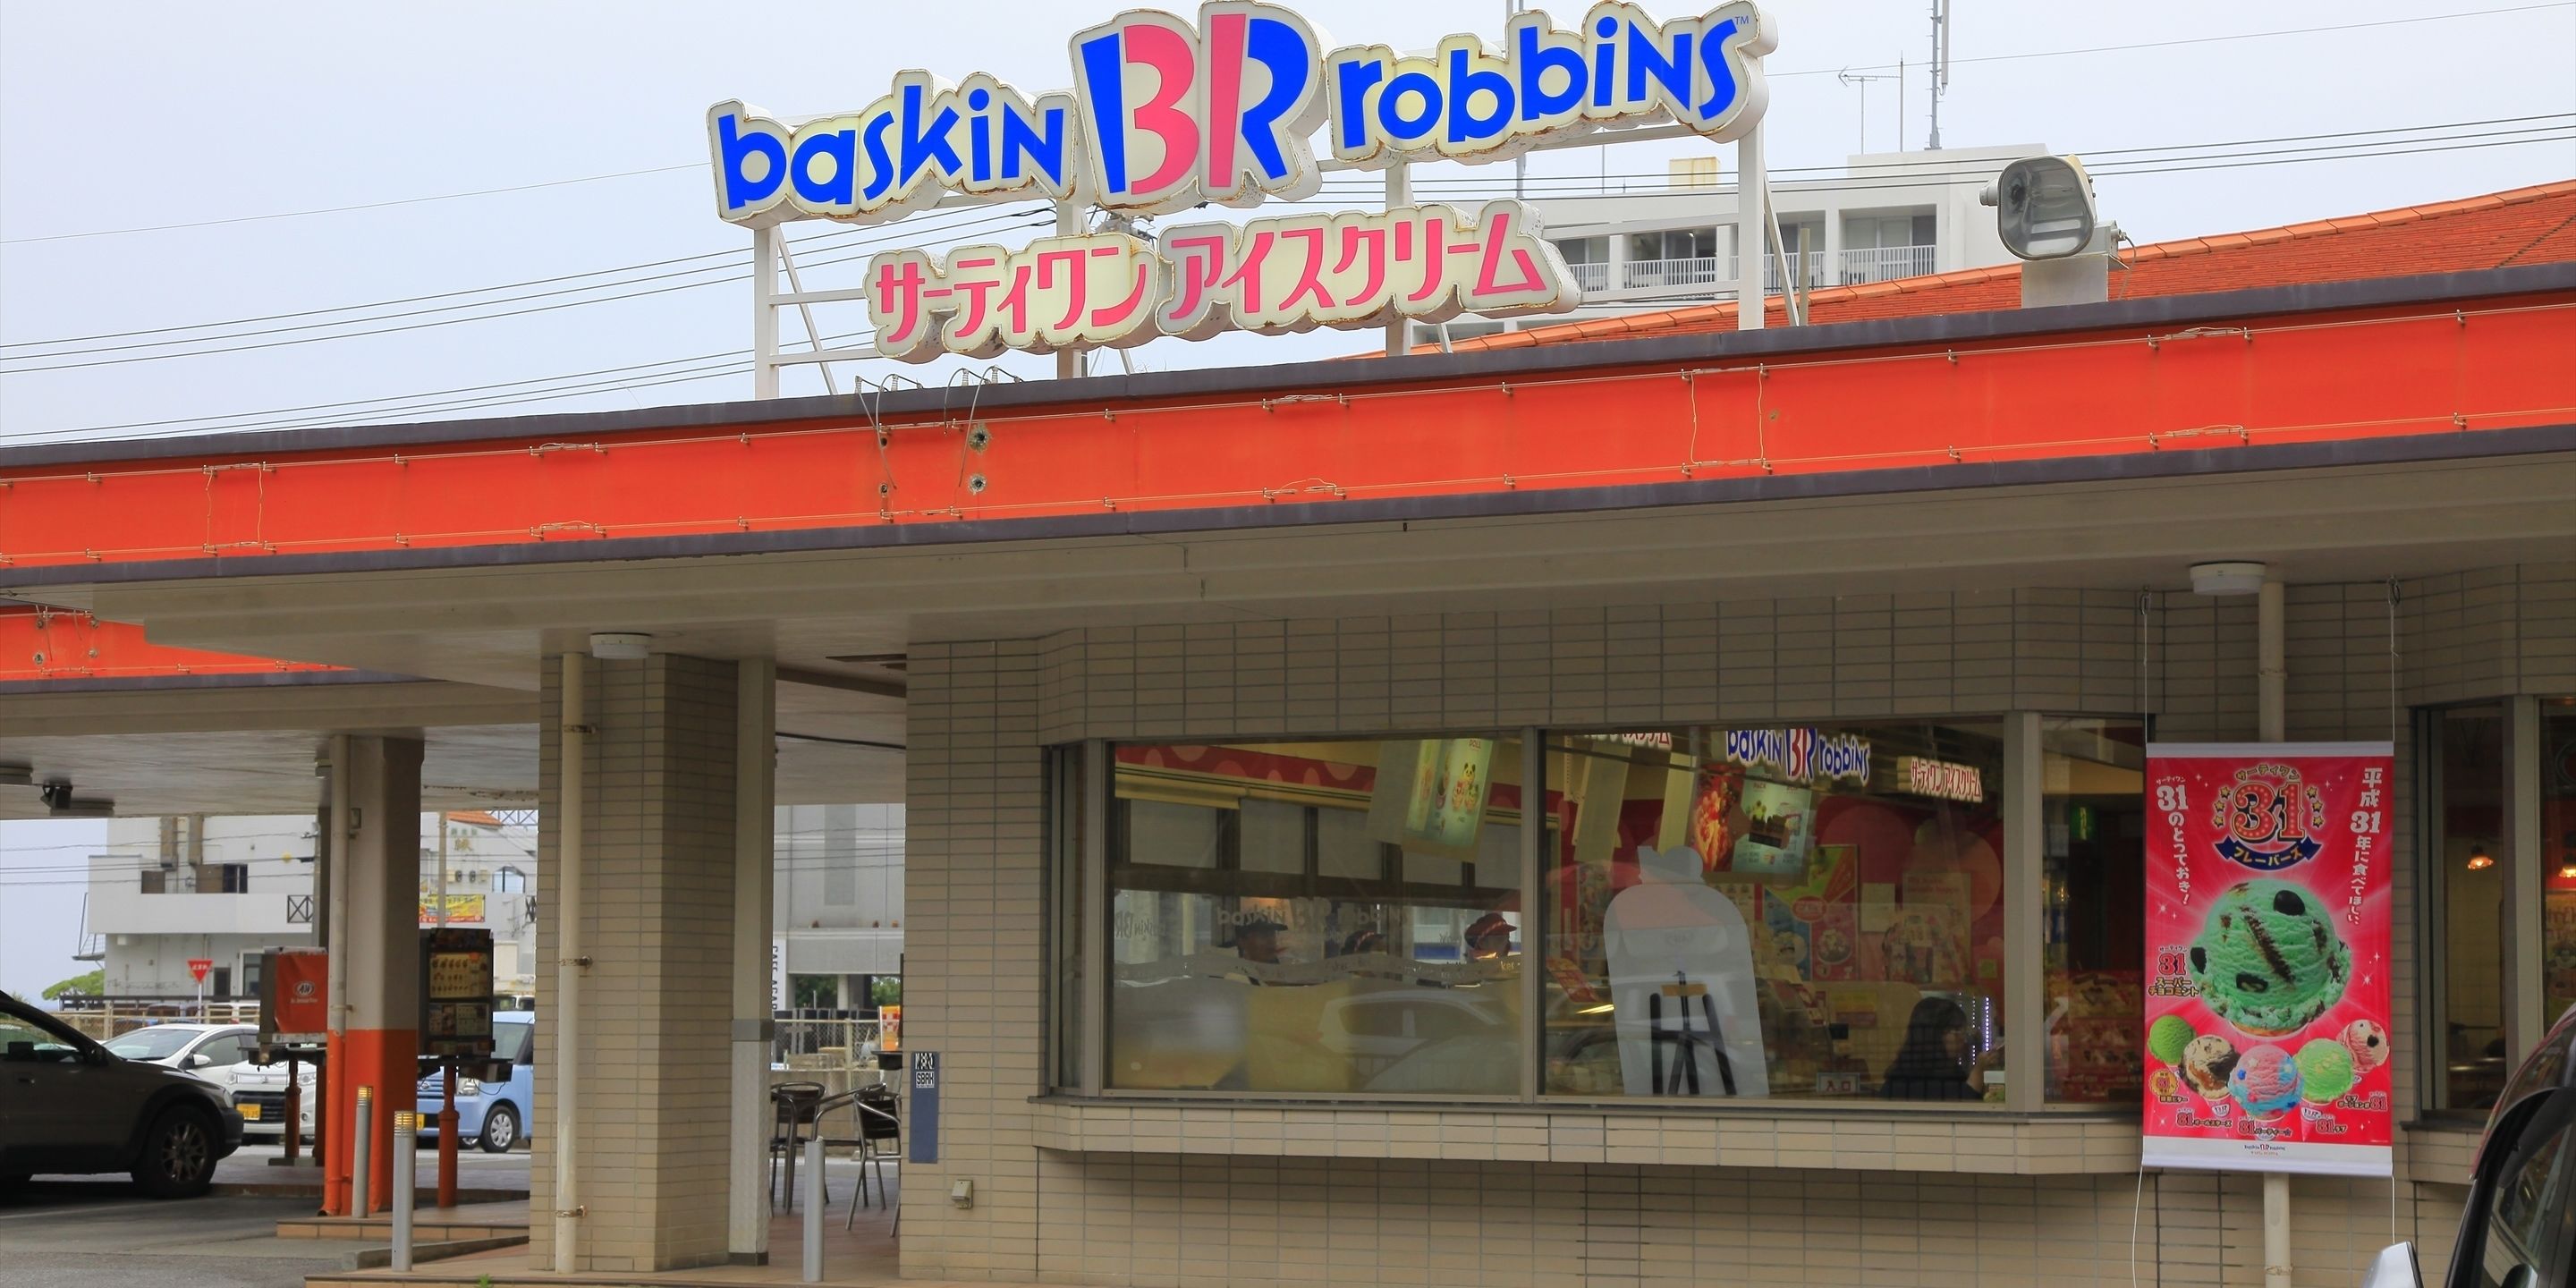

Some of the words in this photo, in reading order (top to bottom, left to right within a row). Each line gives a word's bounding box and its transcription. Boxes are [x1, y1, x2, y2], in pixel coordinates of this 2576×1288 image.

[717, 84, 1063, 210] baskin
[1080, 13, 1309, 195] BR
[1337, 16, 1738, 149] robbins
[875, 246, 1147, 343] サーティワン
[1169, 212, 1547, 320] アイスクリーム
[1818, 737, 1871, 780] robbins
[2235, 764, 2300, 781] サーティワン
[2232, 782, 2305, 843] 31
[2158, 953, 2186, 975] 31
[2148, 987, 2199, 997] チョコミント
[2156, 977, 2192, 987] スーパー
